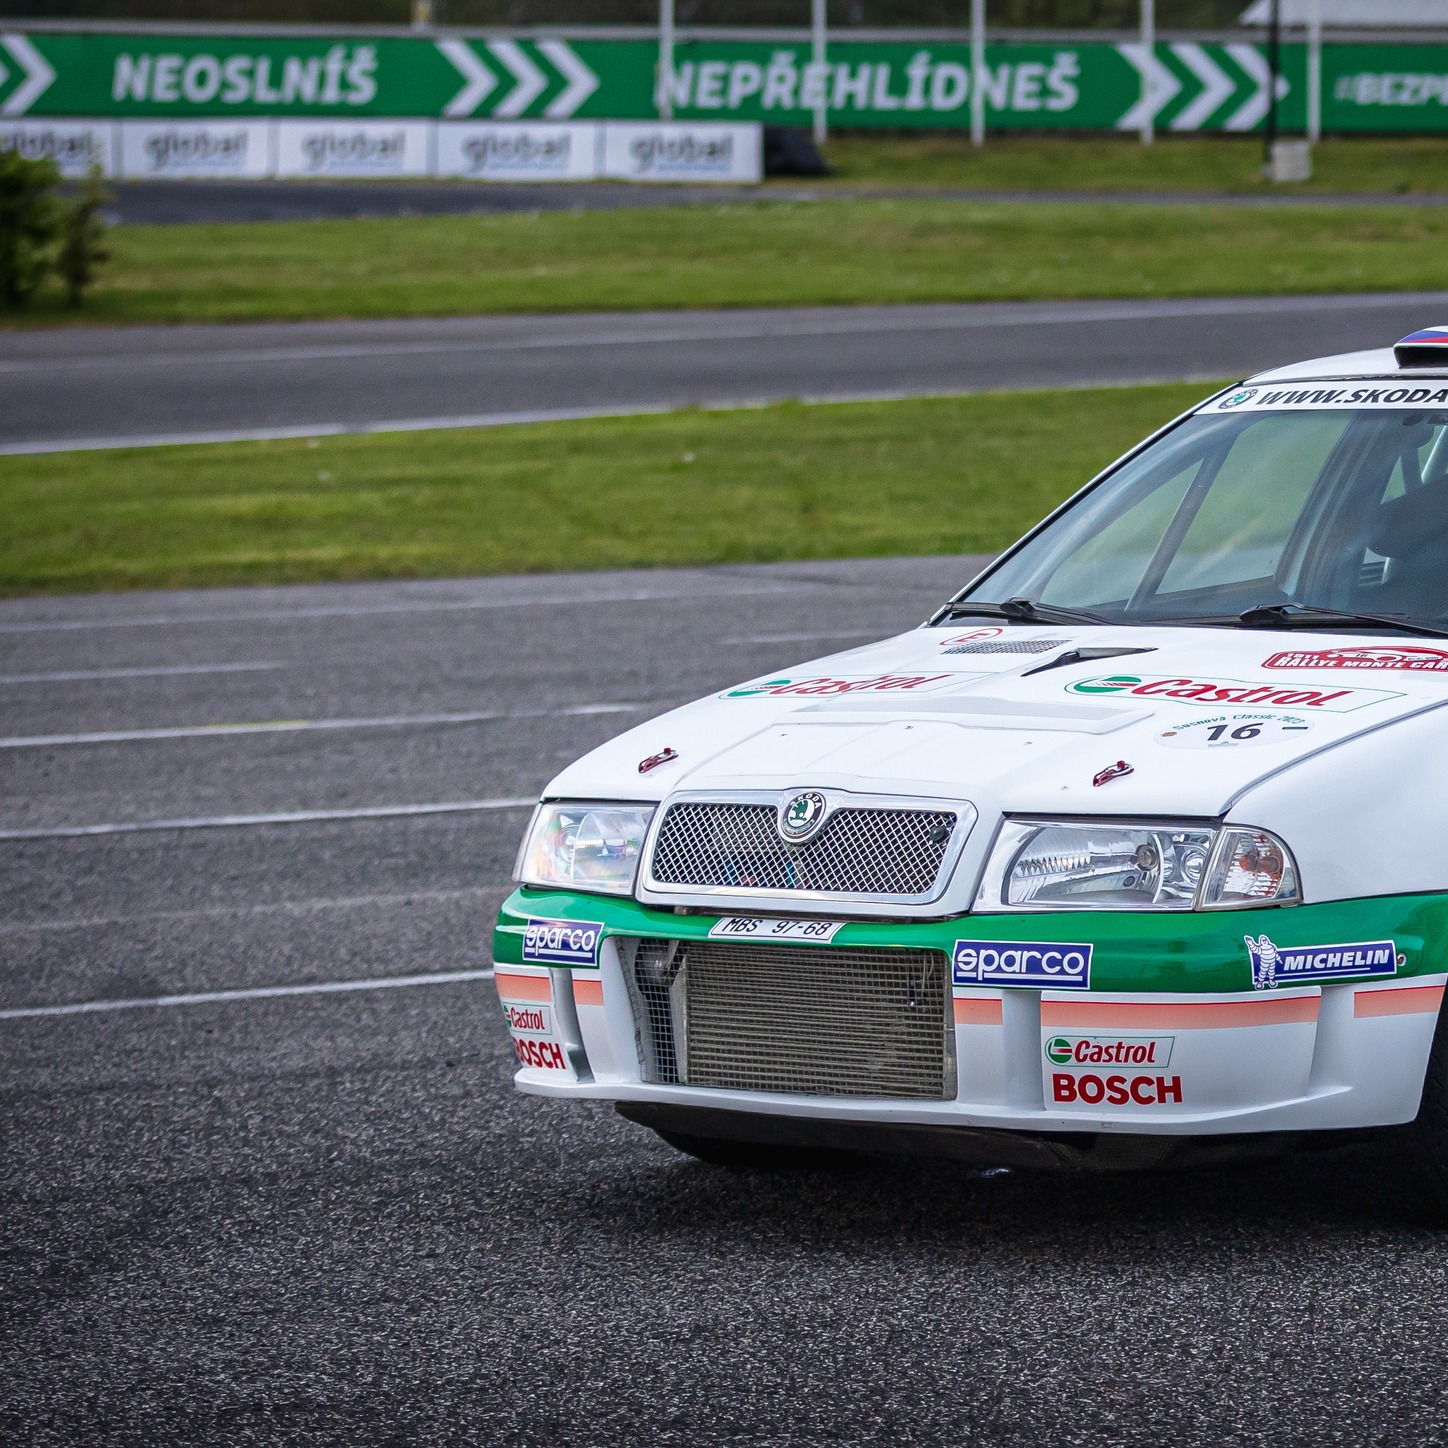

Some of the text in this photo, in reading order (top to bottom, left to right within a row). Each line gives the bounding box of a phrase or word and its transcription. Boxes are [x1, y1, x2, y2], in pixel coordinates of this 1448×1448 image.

[112, 45, 379, 104] NEOSLNÍŠ
[462, 131, 570, 173] global
[631, 133, 733, 173] global
[1273, 656, 1339, 668] RALLYE
[1342, 660, 1406, 668] MONTE
[769, 673, 956, 695] Castrol
[1131, 678, 1355, 707] Castrol
[1207, 722, 1264, 741] 16
[526, 924, 595, 956] sparco
[721, 918, 833, 936] MBS 97-68
[957, 948, 1085, 980] sparco
[1283, 947, 1391, 971] MICHELIN
[510, 1006, 545, 1030] Castrol
[1075, 1038, 1156, 1064] Castrol
[1052, 1073, 1183, 1106] BOSCH
